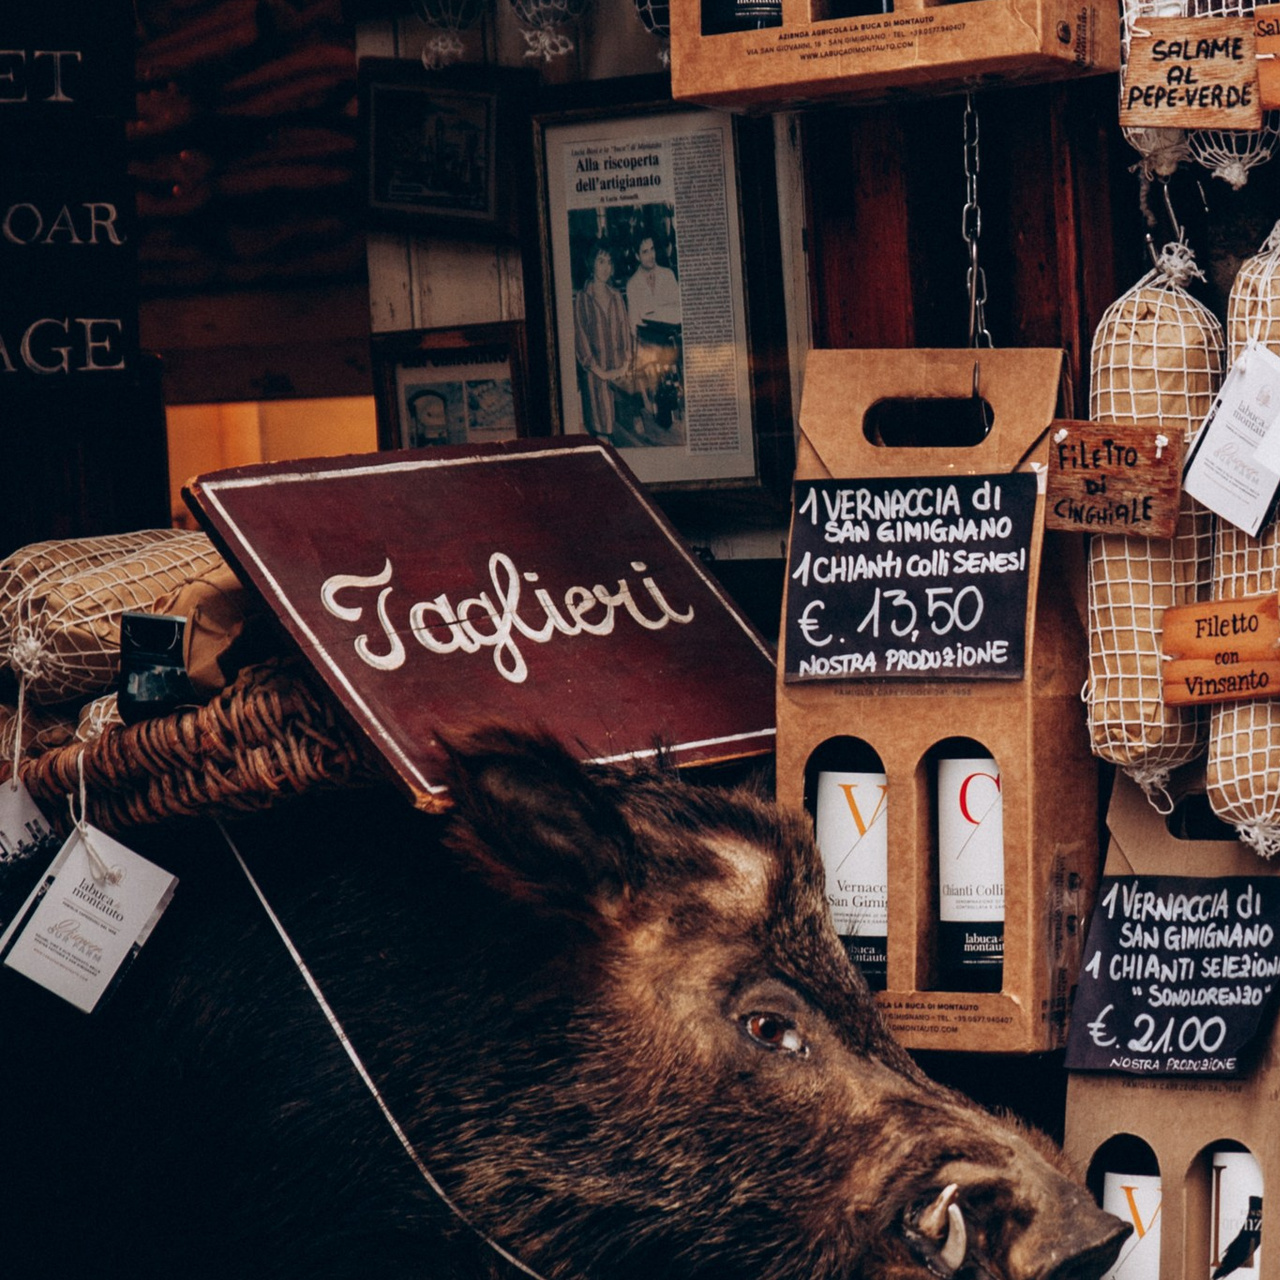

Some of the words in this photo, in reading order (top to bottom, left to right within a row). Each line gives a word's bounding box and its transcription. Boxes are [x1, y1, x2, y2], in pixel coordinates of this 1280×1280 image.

[1152, 37, 1244, 62] SALAME
[1167, 65, 1198, 86] AL
[1127, 80, 1254, 110] PEPE-VERDE
[575, 157, 599, 173] Alla
[604, 153, 660, 171] riscoperta
[821, 484, 961, 521] VERNACCIA
[824, 520, 870, 544] SAN
[876, 516, 1013, 544] GIMIGNANO
[953, 547, 1026, 574] SENESI
[320, 551, 695, 684] Taglieri
[857, 585, 984, 642] 13,50
[1195, 610, 1259, 639] Filetto
[799, 650, 877, 677] NOSTRA
[885, 640, 1009, 672] PRODUZIONE
[1215, 648, 1240, 666] con
[1184, 671, 1270, 698] Vinsanto
[1122, 880, 1229, 922] VERNACCIA
[1119, 923, 1160, 949] SAN
[1164, 922, 1274, 951] GIMIGNANO
[1109, 954, 1195, 983] CHIANTI
[1127, 1013, 1227, 1054] 21.00
[1109, 1056, 1160, 1071] NOSTRA
